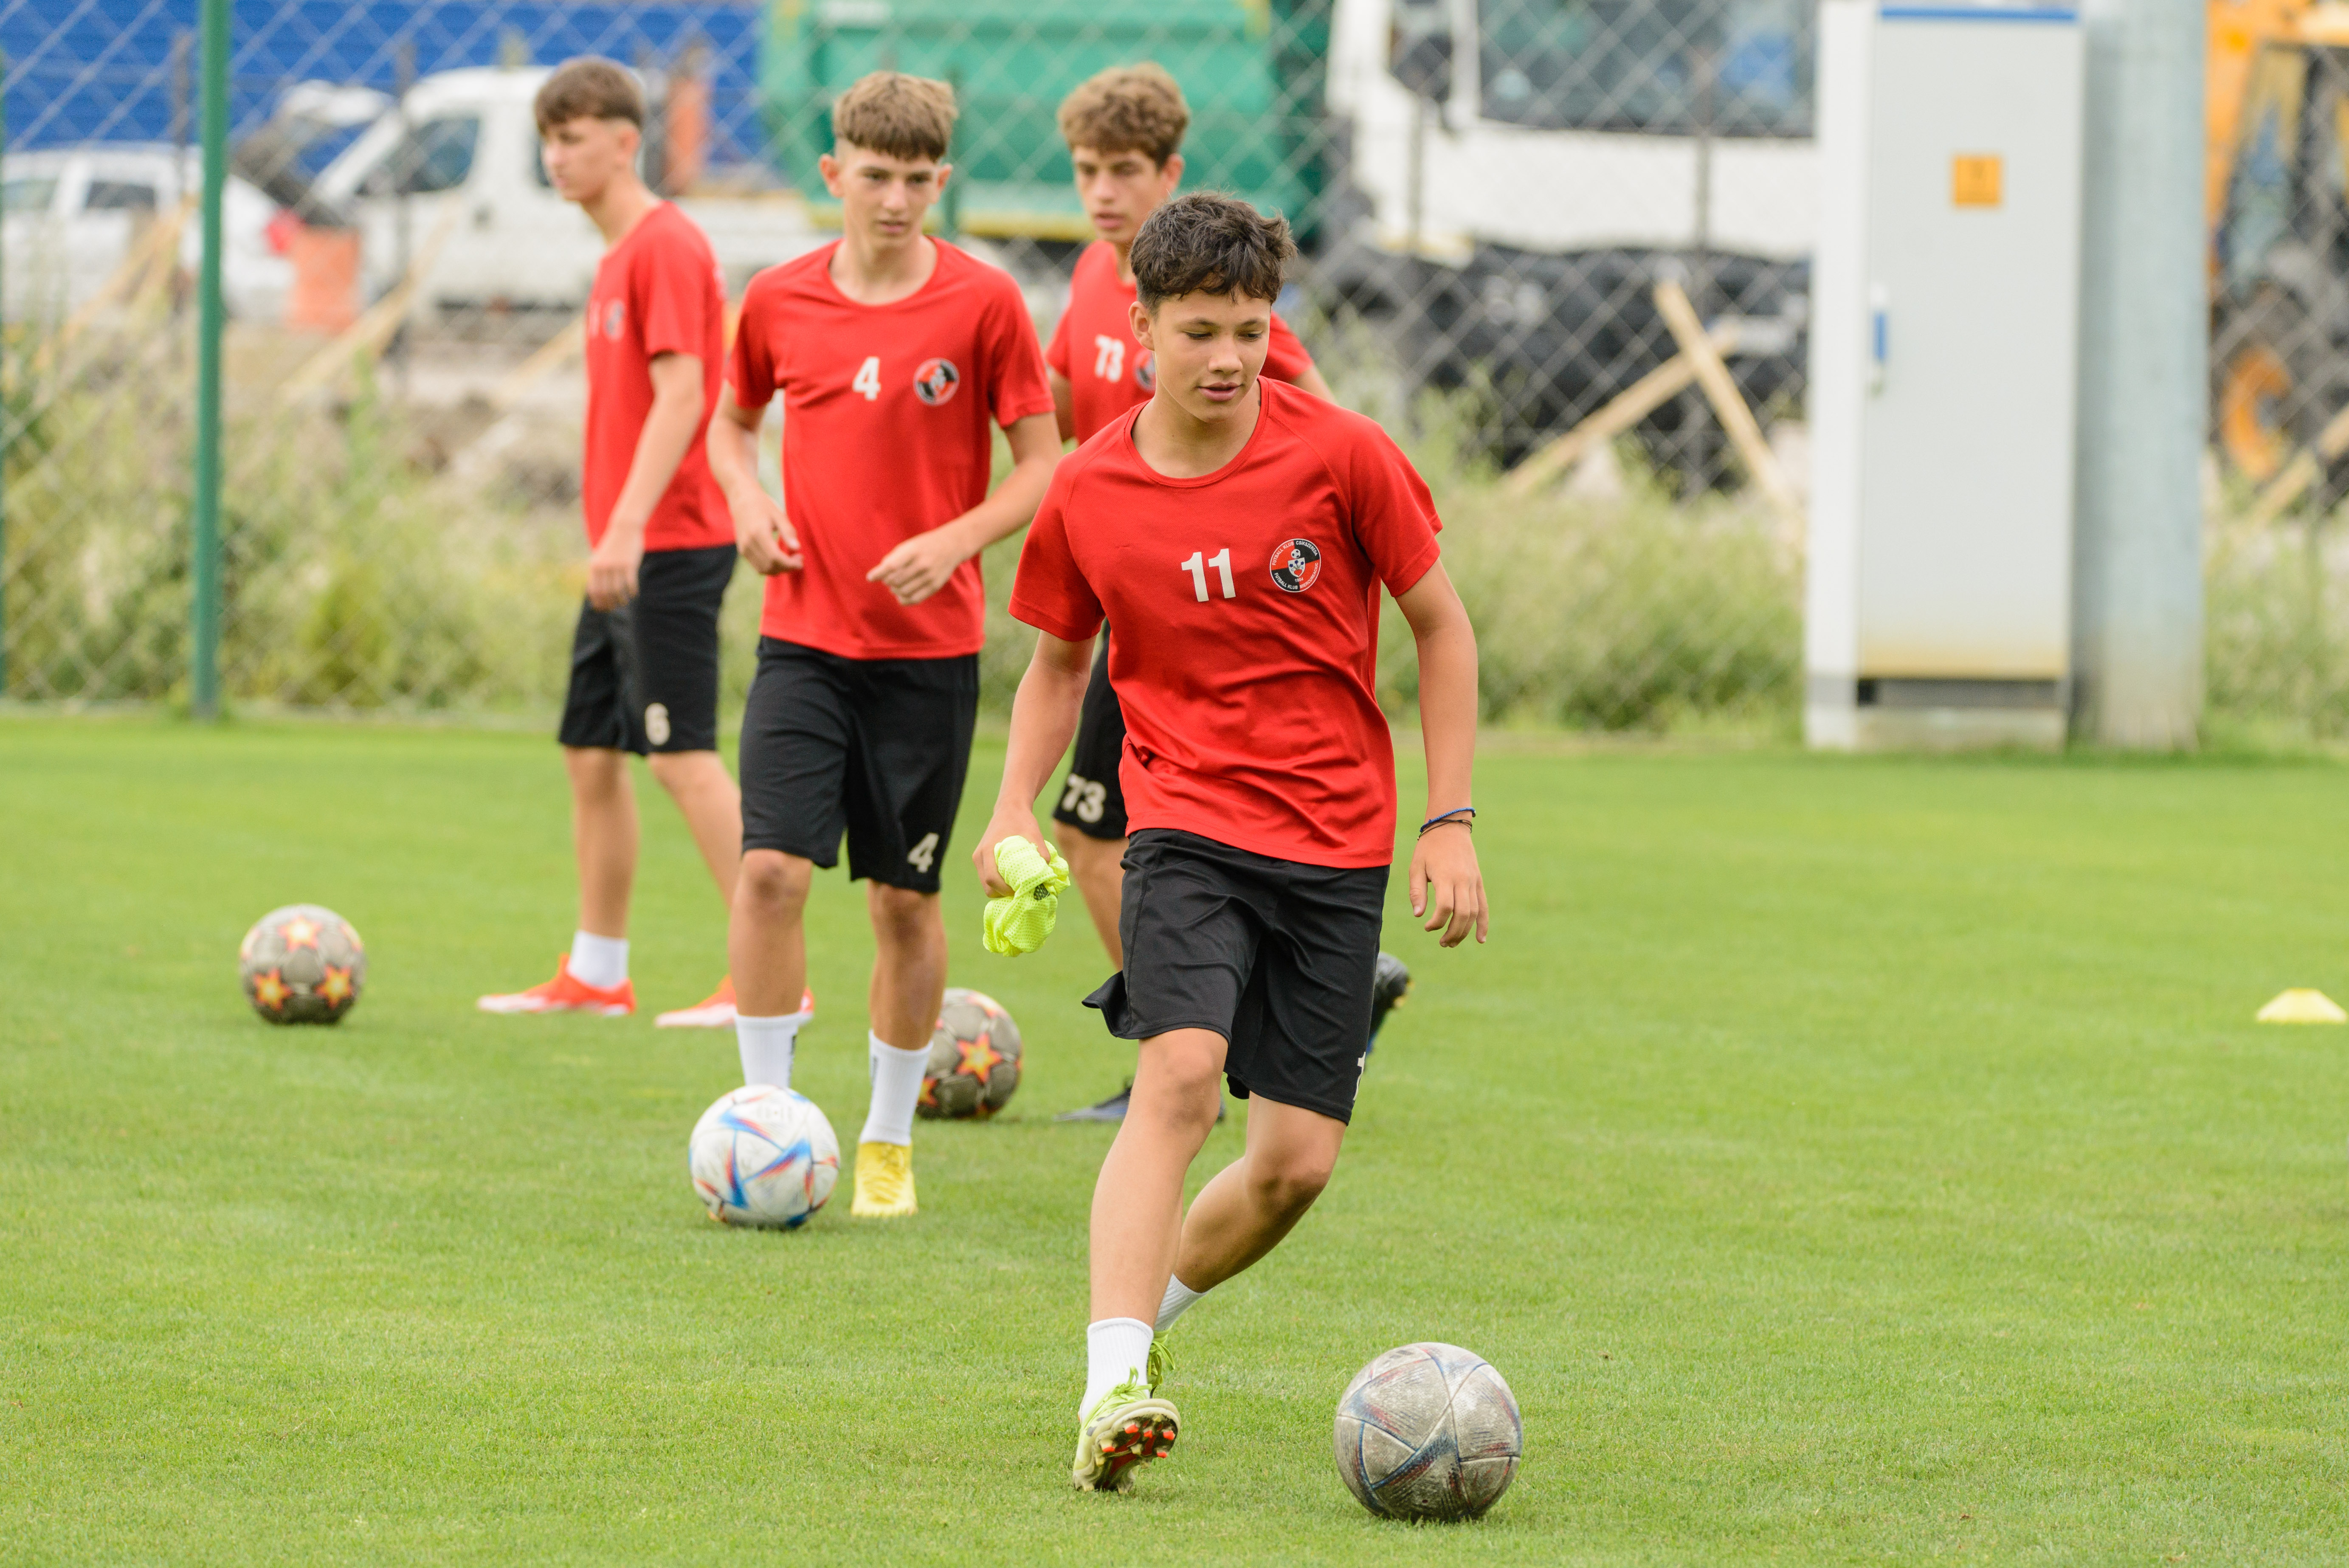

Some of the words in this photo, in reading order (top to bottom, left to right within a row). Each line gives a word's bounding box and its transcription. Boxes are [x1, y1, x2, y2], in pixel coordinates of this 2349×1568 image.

[853, 357, 880, 400] 4
[1096, 335, 1125, 382] 73
[1272, 549, 1283, 565] FUTBALL
[1296, 540, 1318, 556] CSÍKSZEREDA
[1181, 548, 1236, 602] 11
[1274, 572, 1287, 587] FUTBALL
[1062, 774, 1106, 822] 73
[907, 833, 940, 873] 4
